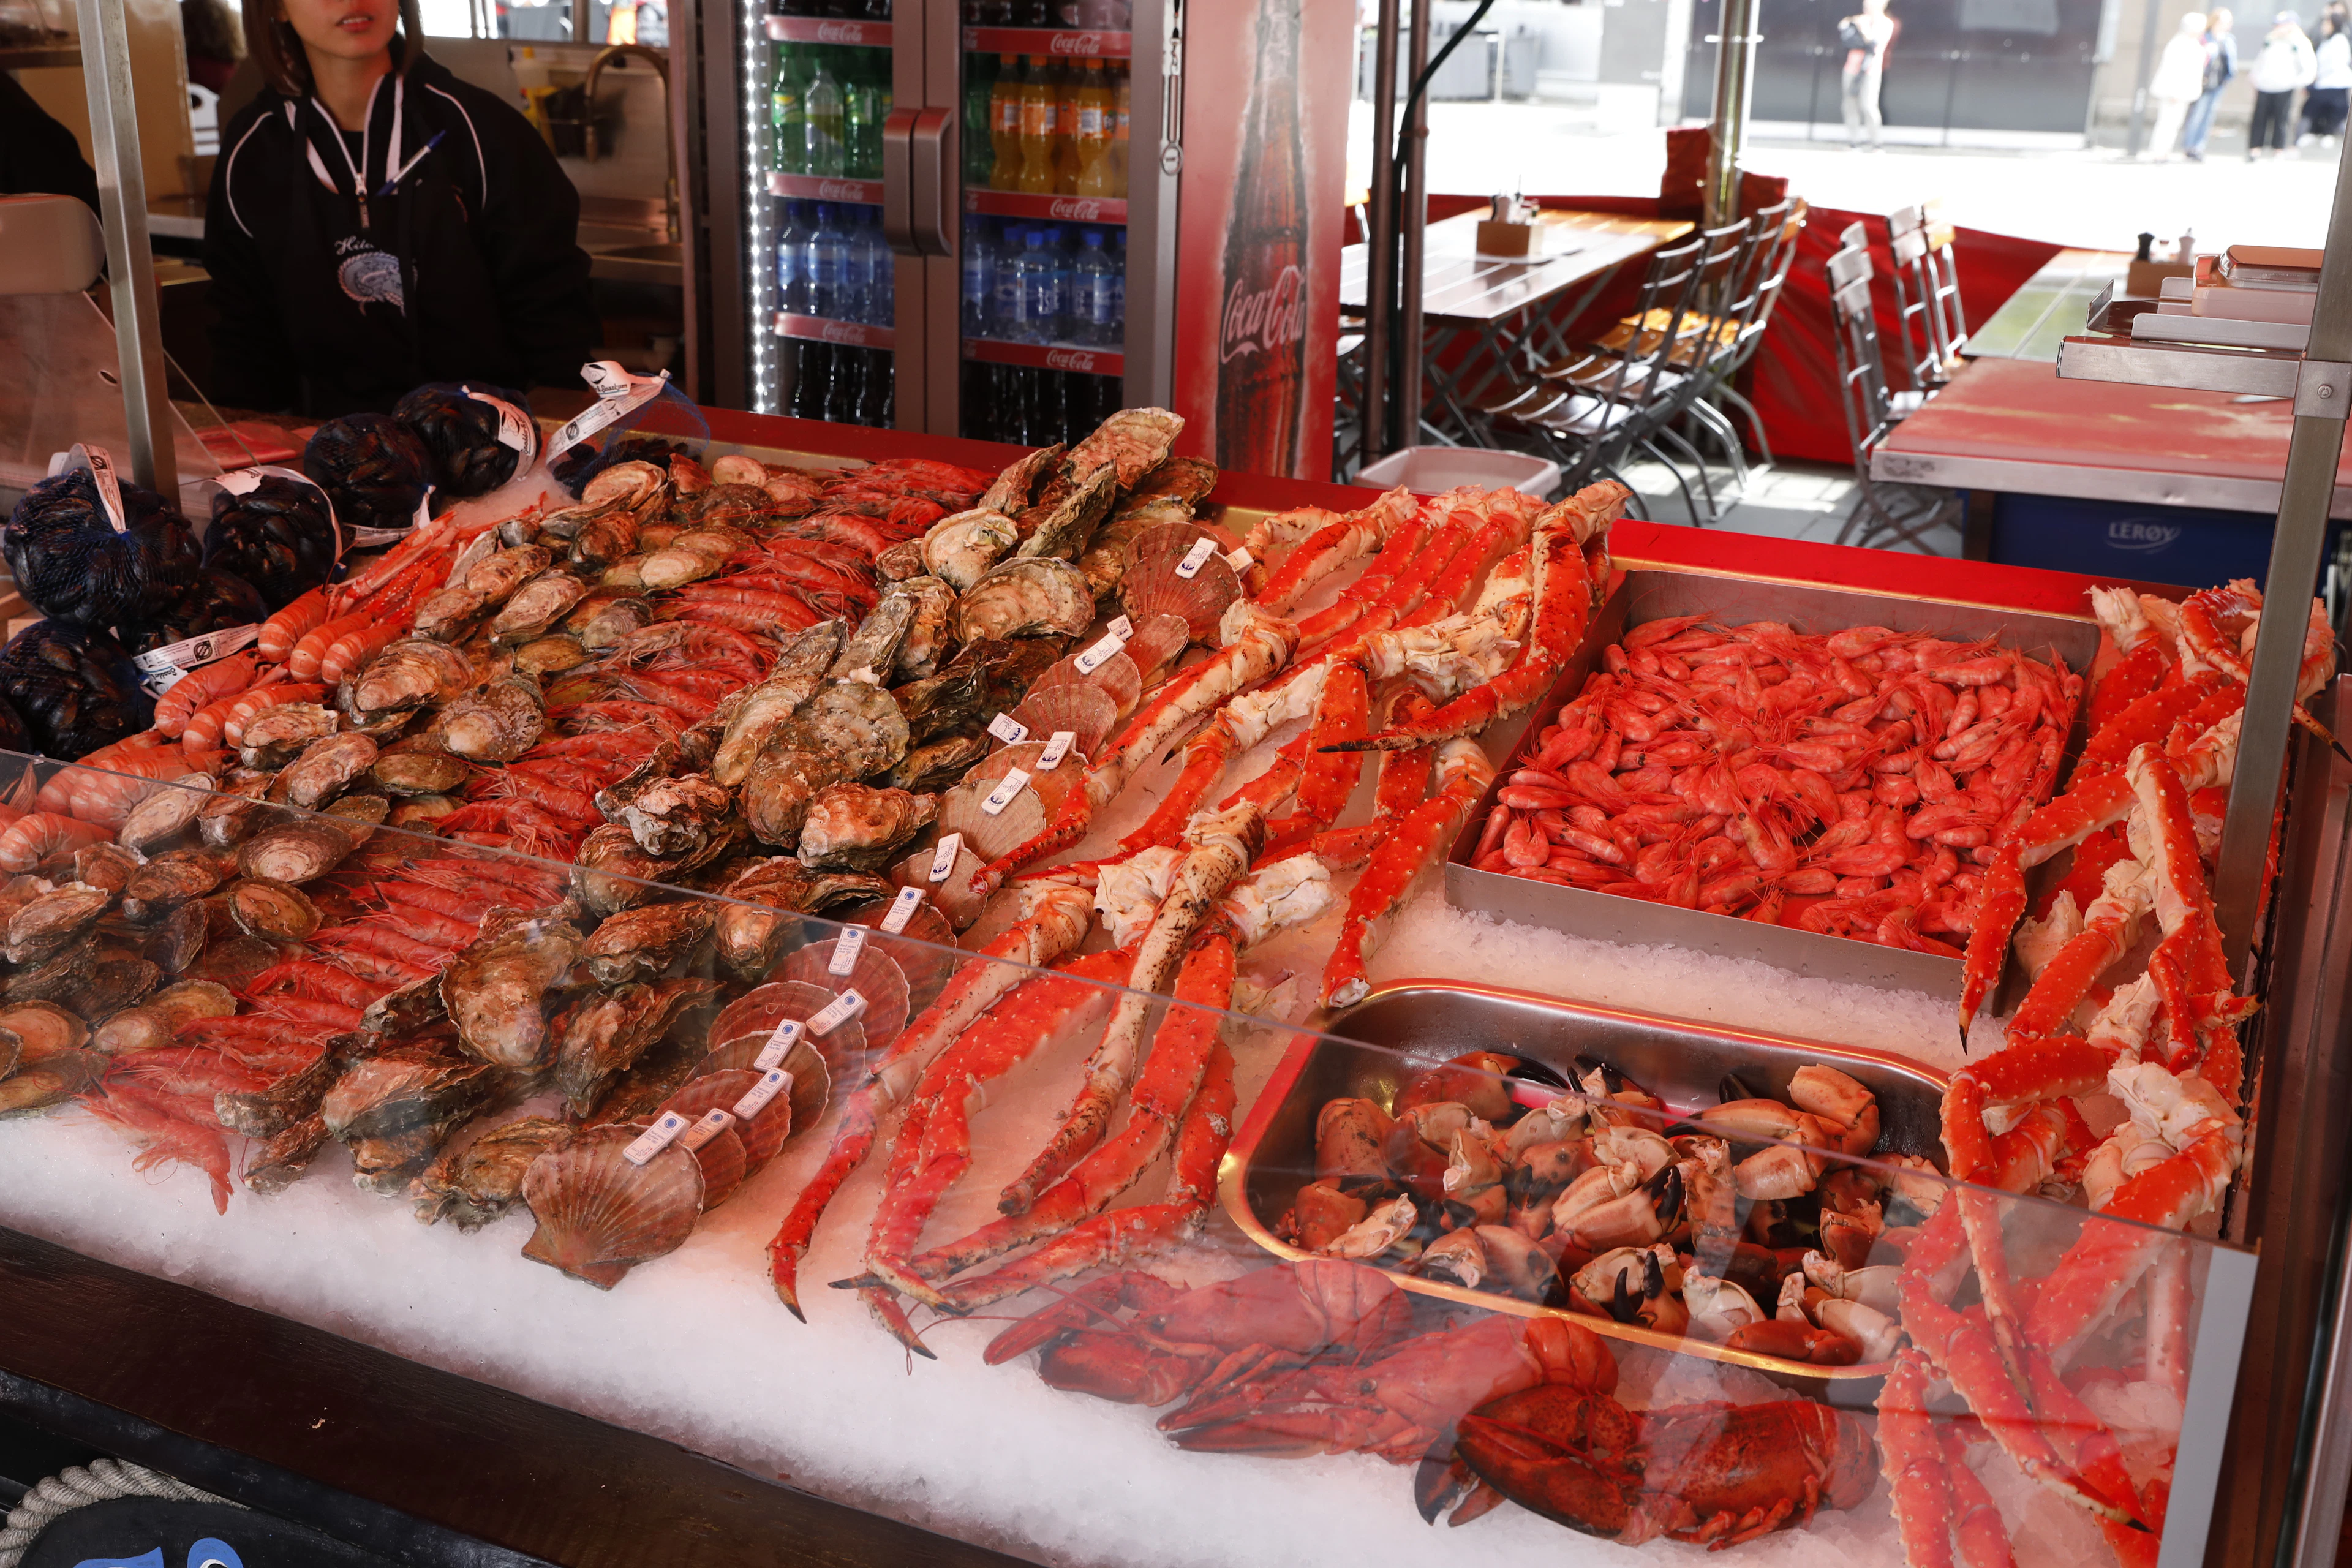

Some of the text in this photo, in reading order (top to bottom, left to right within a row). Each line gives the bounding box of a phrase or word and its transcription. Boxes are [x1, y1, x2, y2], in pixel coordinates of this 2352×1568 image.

[1050, 33, 1100, 55] Coca-Cola
[1050, 198, 1099, 221] Coca-Cola
[1220, 264, 1306, 364] Coca-Cola
[2108, 522, 2174, 541] LERØY
